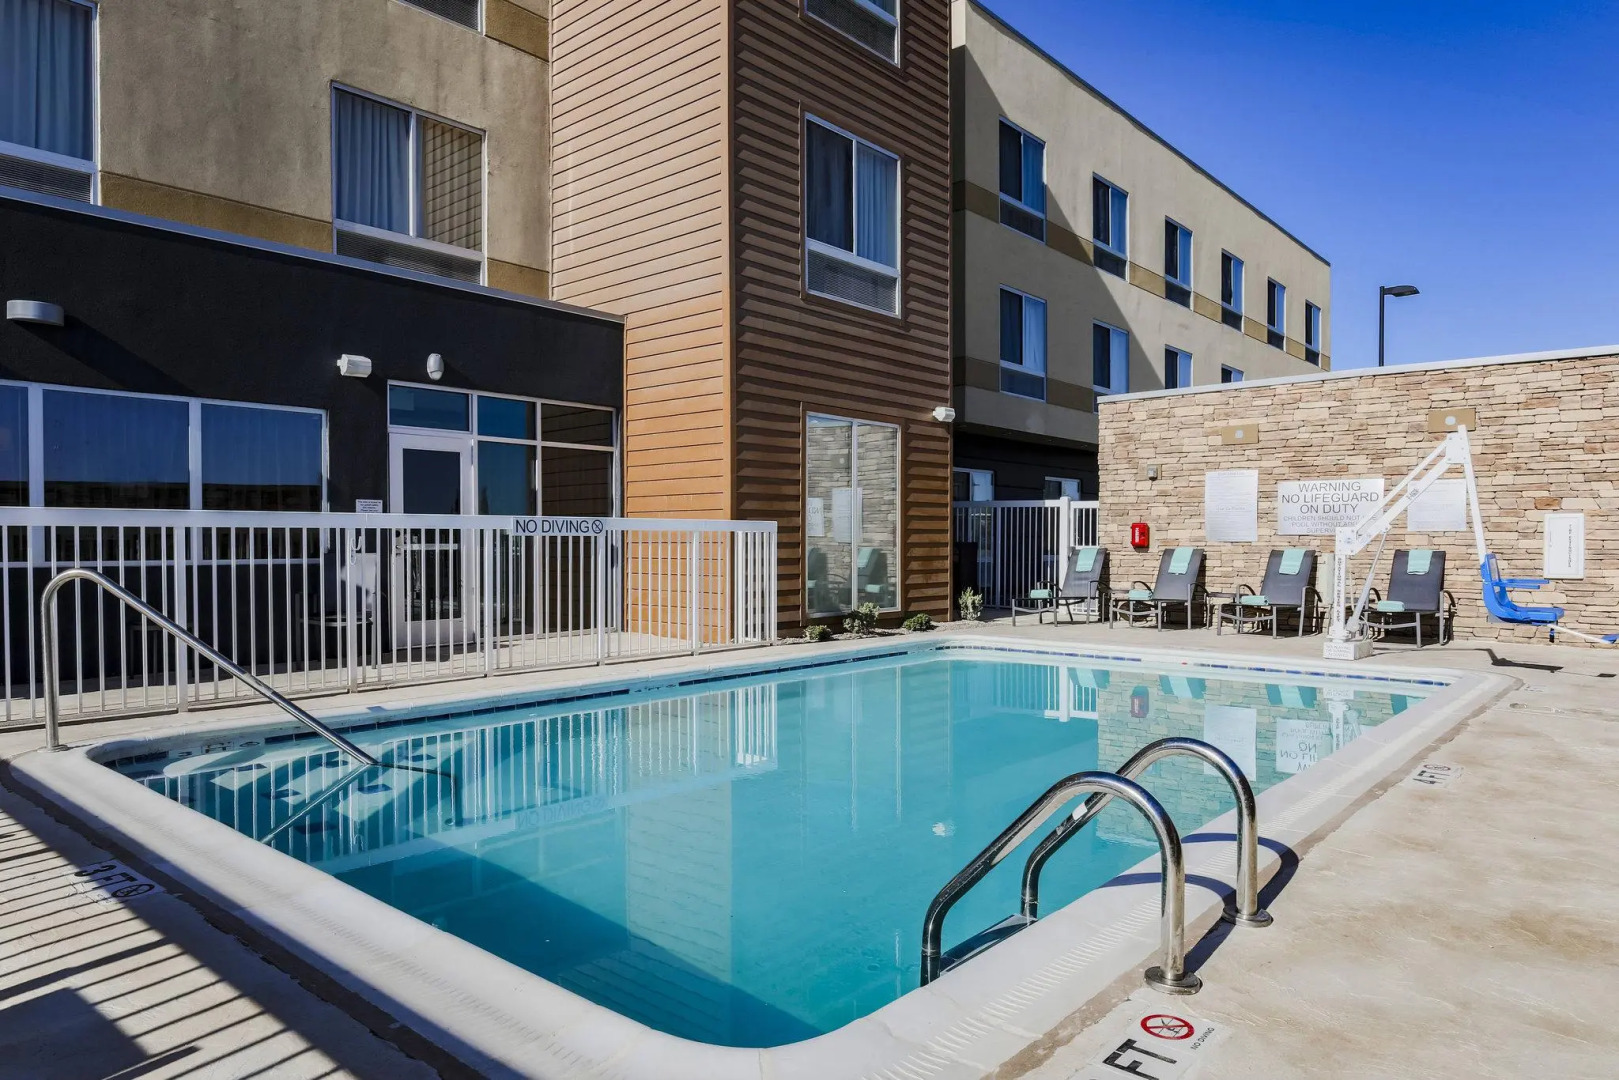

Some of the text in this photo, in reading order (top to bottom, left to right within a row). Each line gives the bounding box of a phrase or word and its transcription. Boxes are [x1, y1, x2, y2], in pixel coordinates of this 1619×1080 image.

[1298, 482, 1361, 492] WARNING
[1281, 492, 1379, 503] NO LIFEGUARD
[1300, 503, 1358, 514] ON DUTY
[515, 519, 590, 533] NO DIVING
[1190, 1027, 1215, 1050] NO DIVING
[1102, 1038, 1177, 1080] FT
